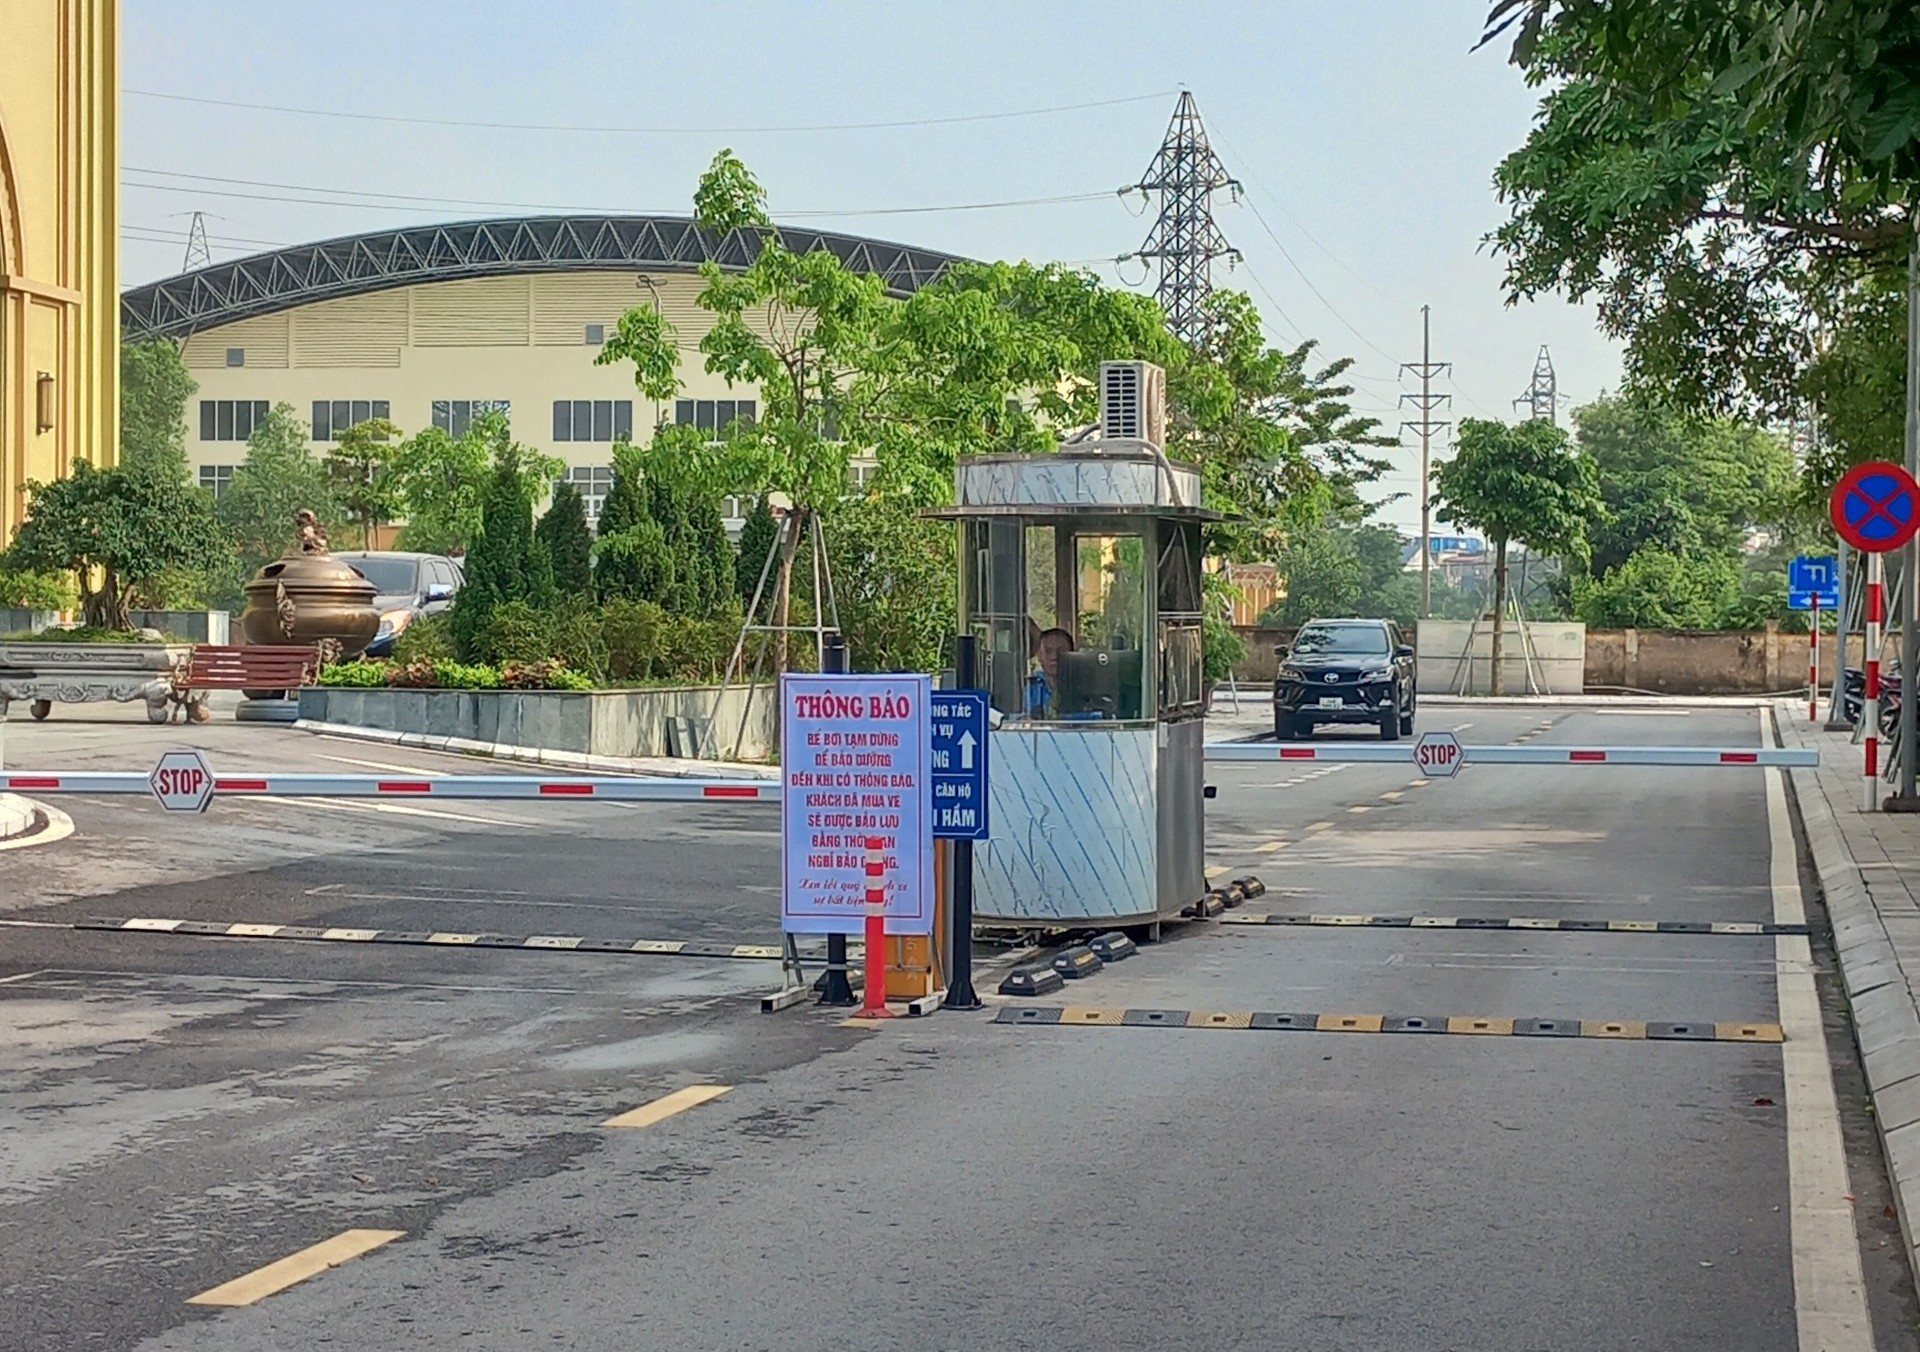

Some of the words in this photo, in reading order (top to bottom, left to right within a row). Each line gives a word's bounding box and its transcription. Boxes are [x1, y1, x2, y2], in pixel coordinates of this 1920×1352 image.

[795, 689, 864, 719] THÔNG
[869, 689, 910, 719] BÁO
[933, 704, 948, 717] NG
[951, 702, 972, 718] TÁC
[939, 723, 954, 739] VỤ
[844, 733, 867, 749] TẠM
[933, 749, 950, 769] NG
[1420, 744, 1457, 765] STOP
[159, 768, 203, 795] STOP
[791, 769, 813, 787] ĐẾN
[816, 773, 833, 787] KHI
[836, 771, 850, 787] CÓ
[853, 771, 888, 788] THÔNG
[890, 771, 915, 788] BÁO.
[806, 790, 841, 807] KHÁCH
[844, 791, 858, 807] ĐÃ
[861, 794, 885, 808] MUA
[957, 782, 971, 799] HỘ
[824, 813, 853, 830] ĐƯỢC
